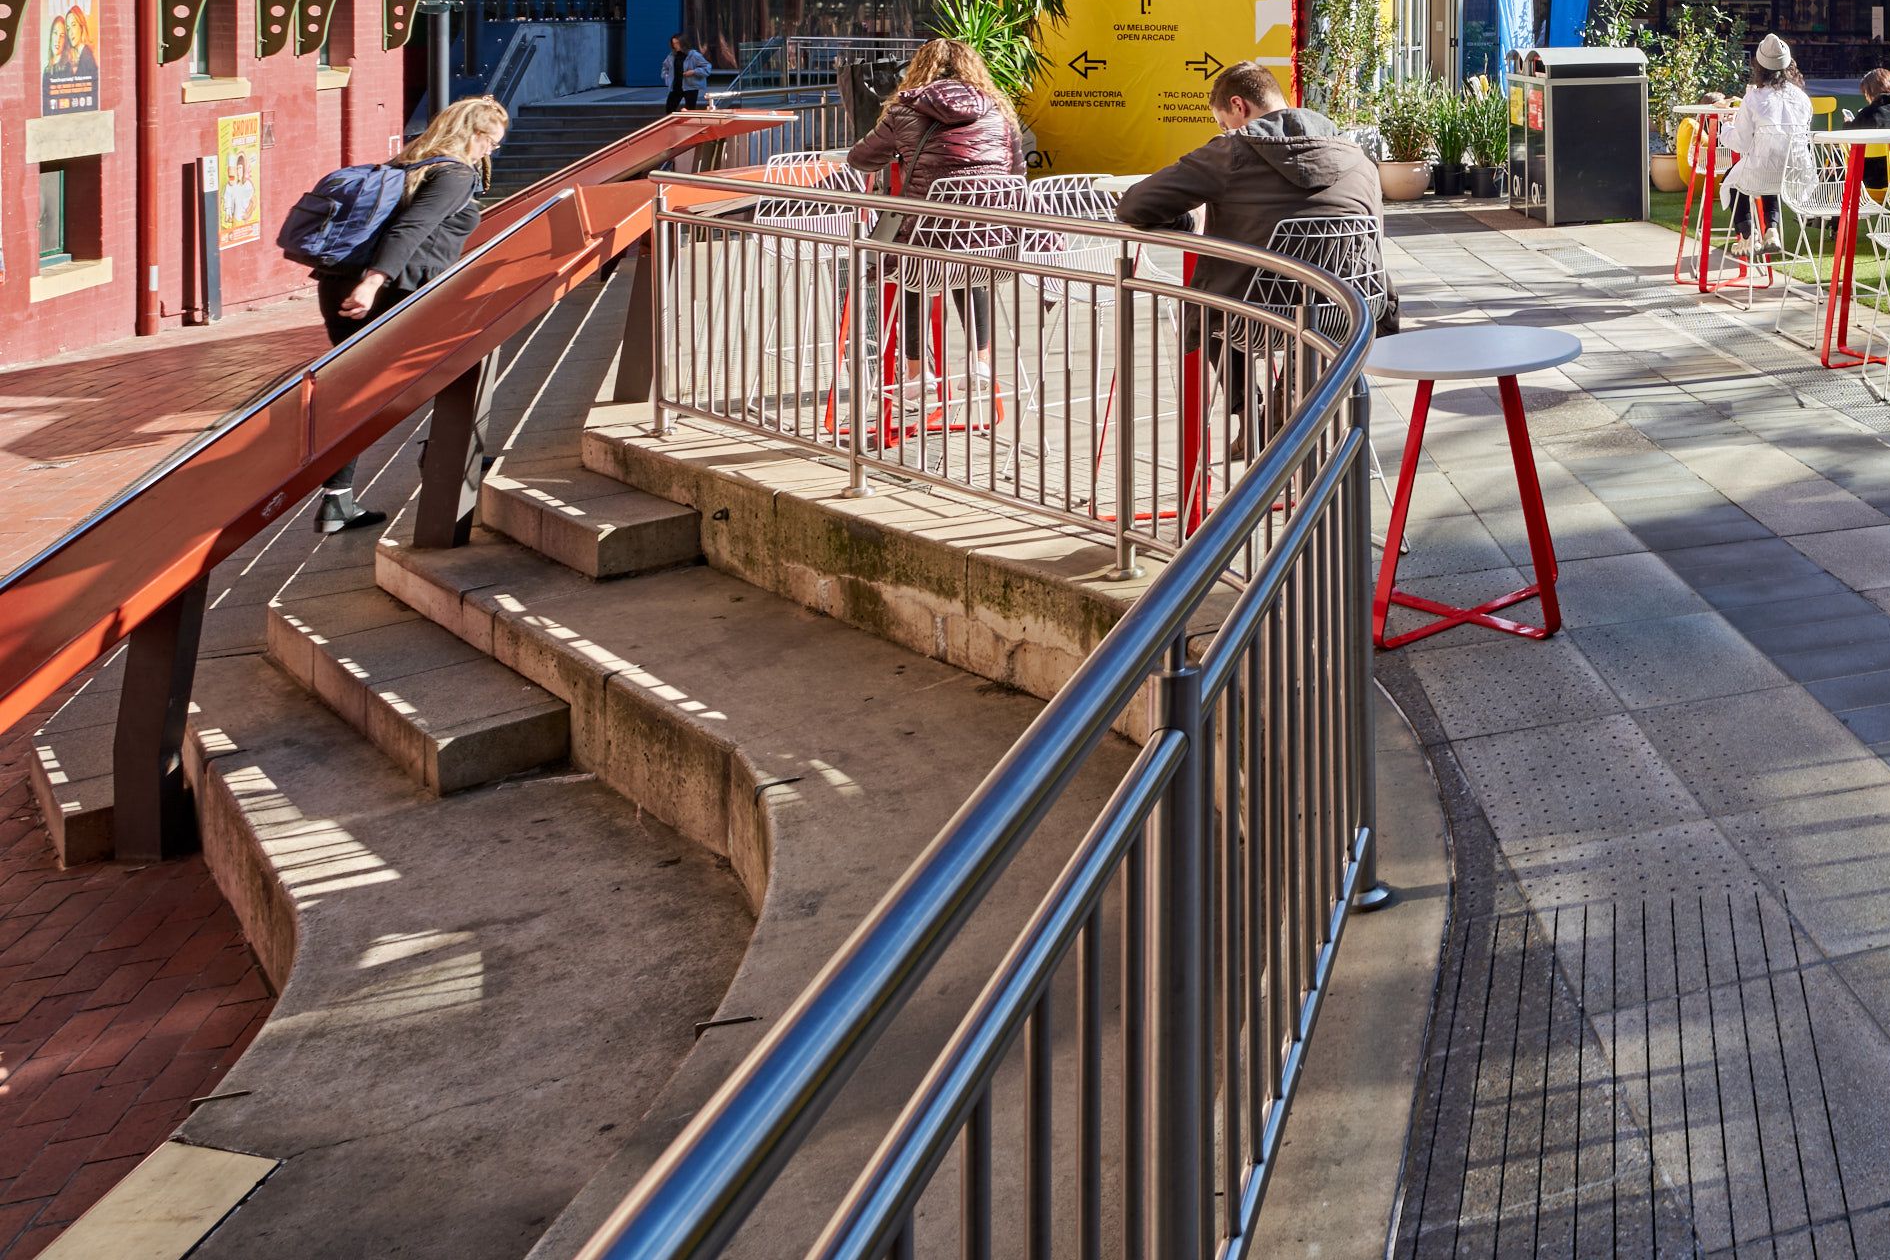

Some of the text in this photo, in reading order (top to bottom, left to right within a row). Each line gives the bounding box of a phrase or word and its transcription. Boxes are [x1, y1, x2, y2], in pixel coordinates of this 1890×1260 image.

[1113, 24, 1179, 32] QV MELBOURNE
[1117, 33, 1176, 41] OPEN ARCADE
[1053, 90, 1123, 98] QUEEN VICTORIA
[1163, 91, 1179, 99] TAC
[1050, 100, 1126, 108] WOMEN'S CENTRE
[1177, 104, 1212, 112] VACANC
[1162, 116, 1218, 124] INFORMATIO
[1026, 149, 1060, 170] QV
